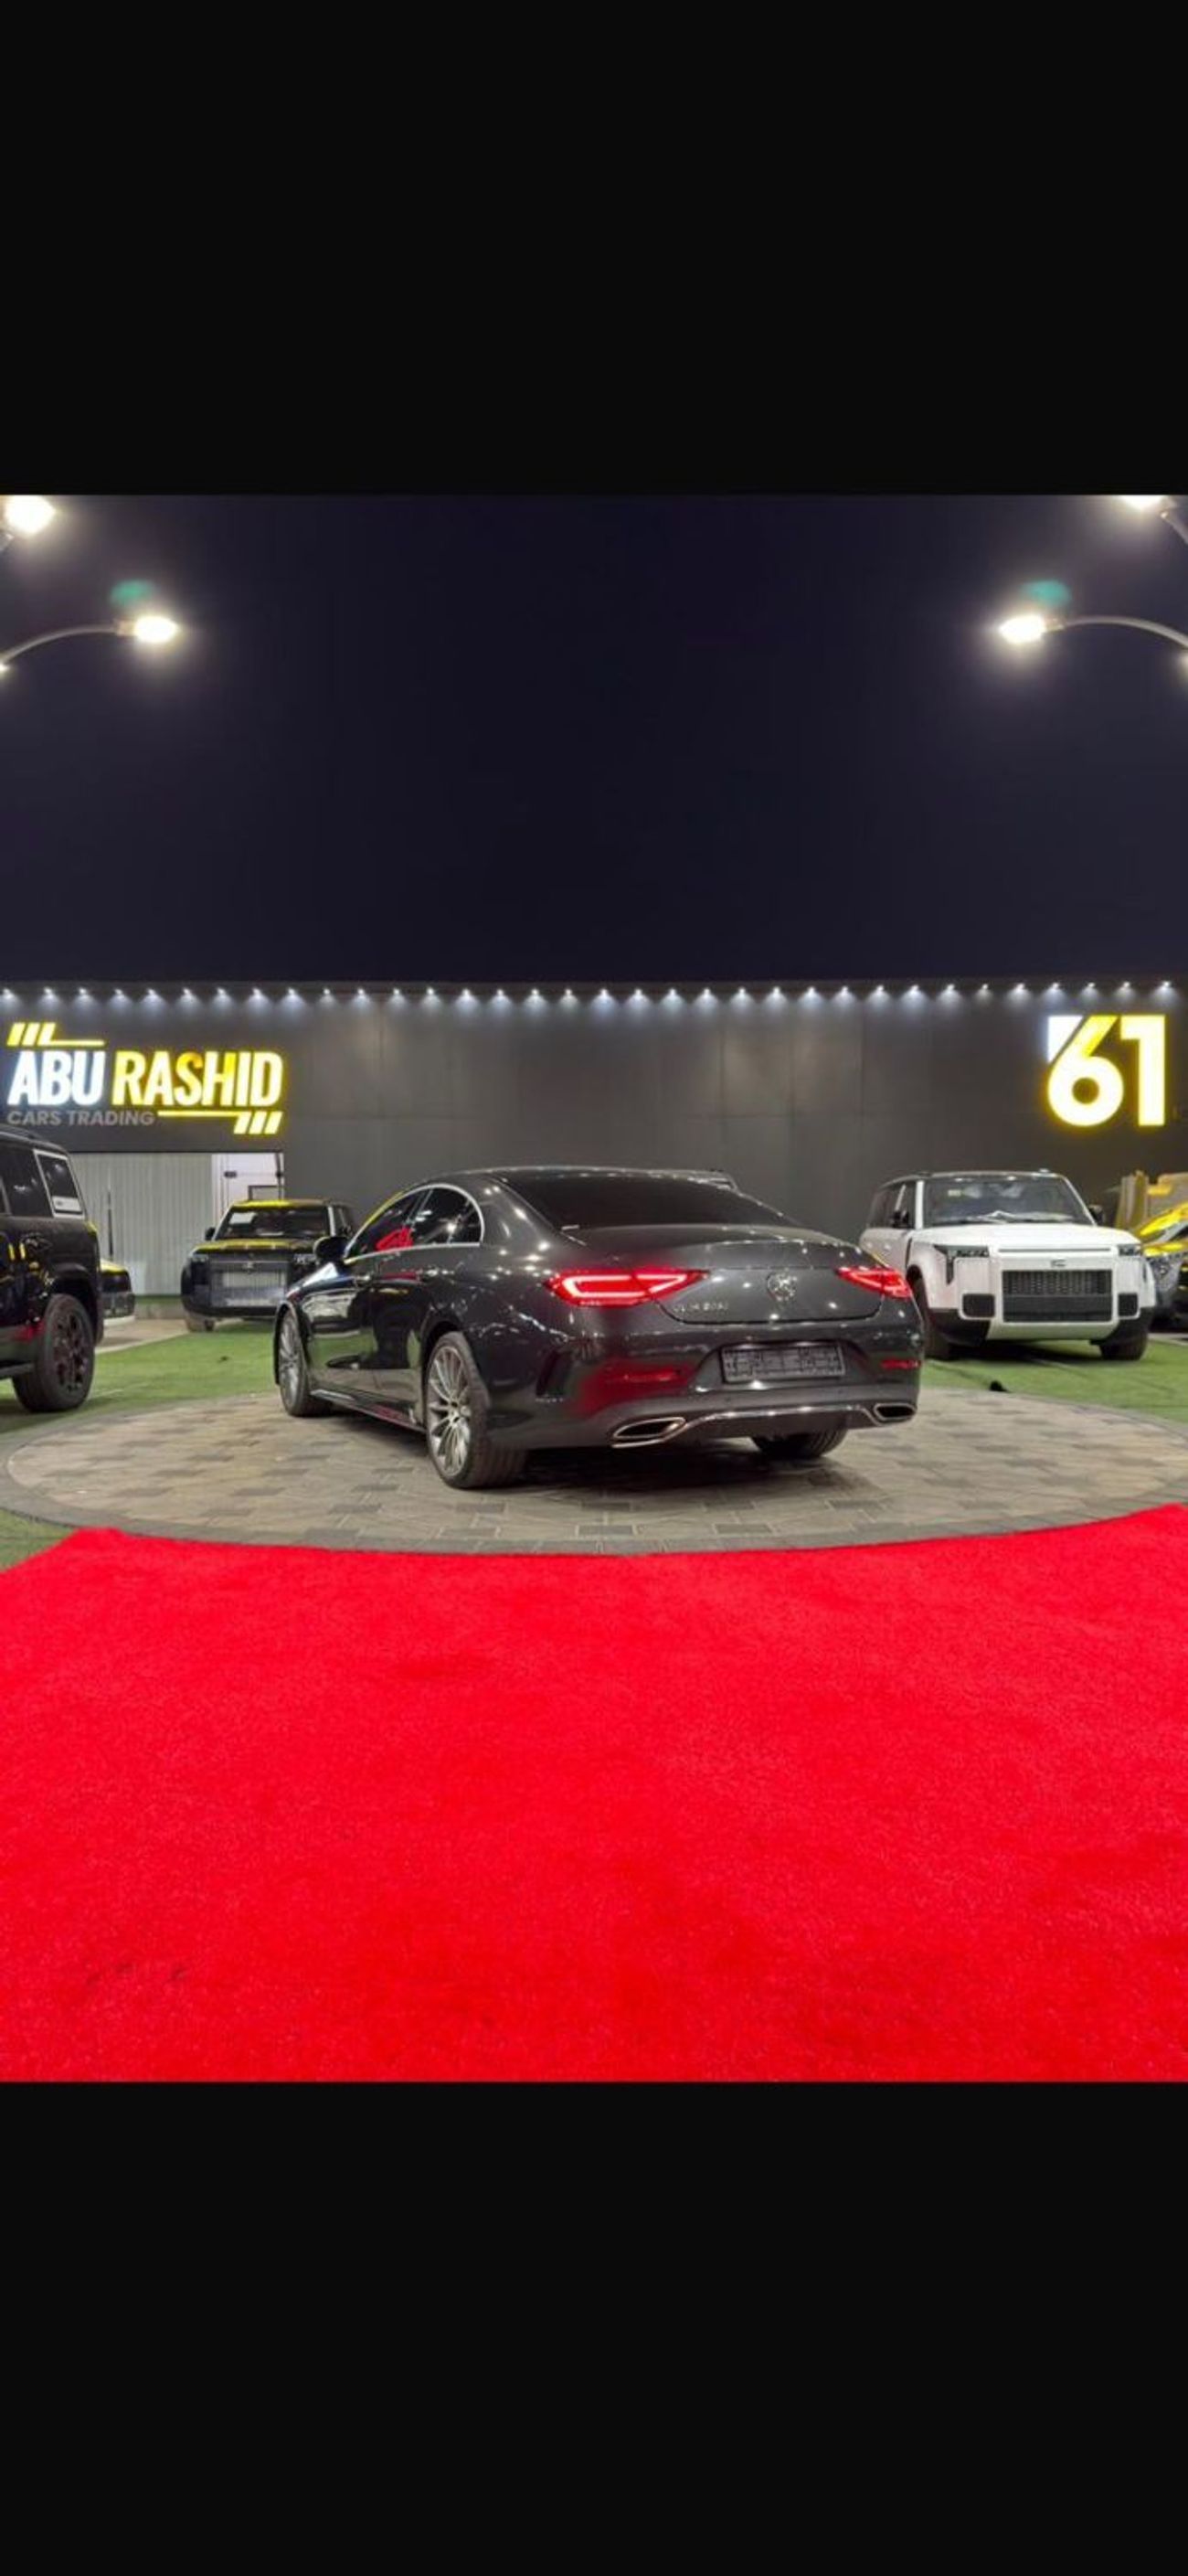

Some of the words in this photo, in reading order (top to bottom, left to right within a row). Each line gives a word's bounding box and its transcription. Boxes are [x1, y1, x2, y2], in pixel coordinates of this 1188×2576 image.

[6, 1050, 106, 1106] ABU
[111, 1050, 283, 1107] RASHID
[1047, 1015, 1165, 1127] 61
[6, 1111, 62, 1125] CARS
[67, 1110, 155, 1126] TRADING
